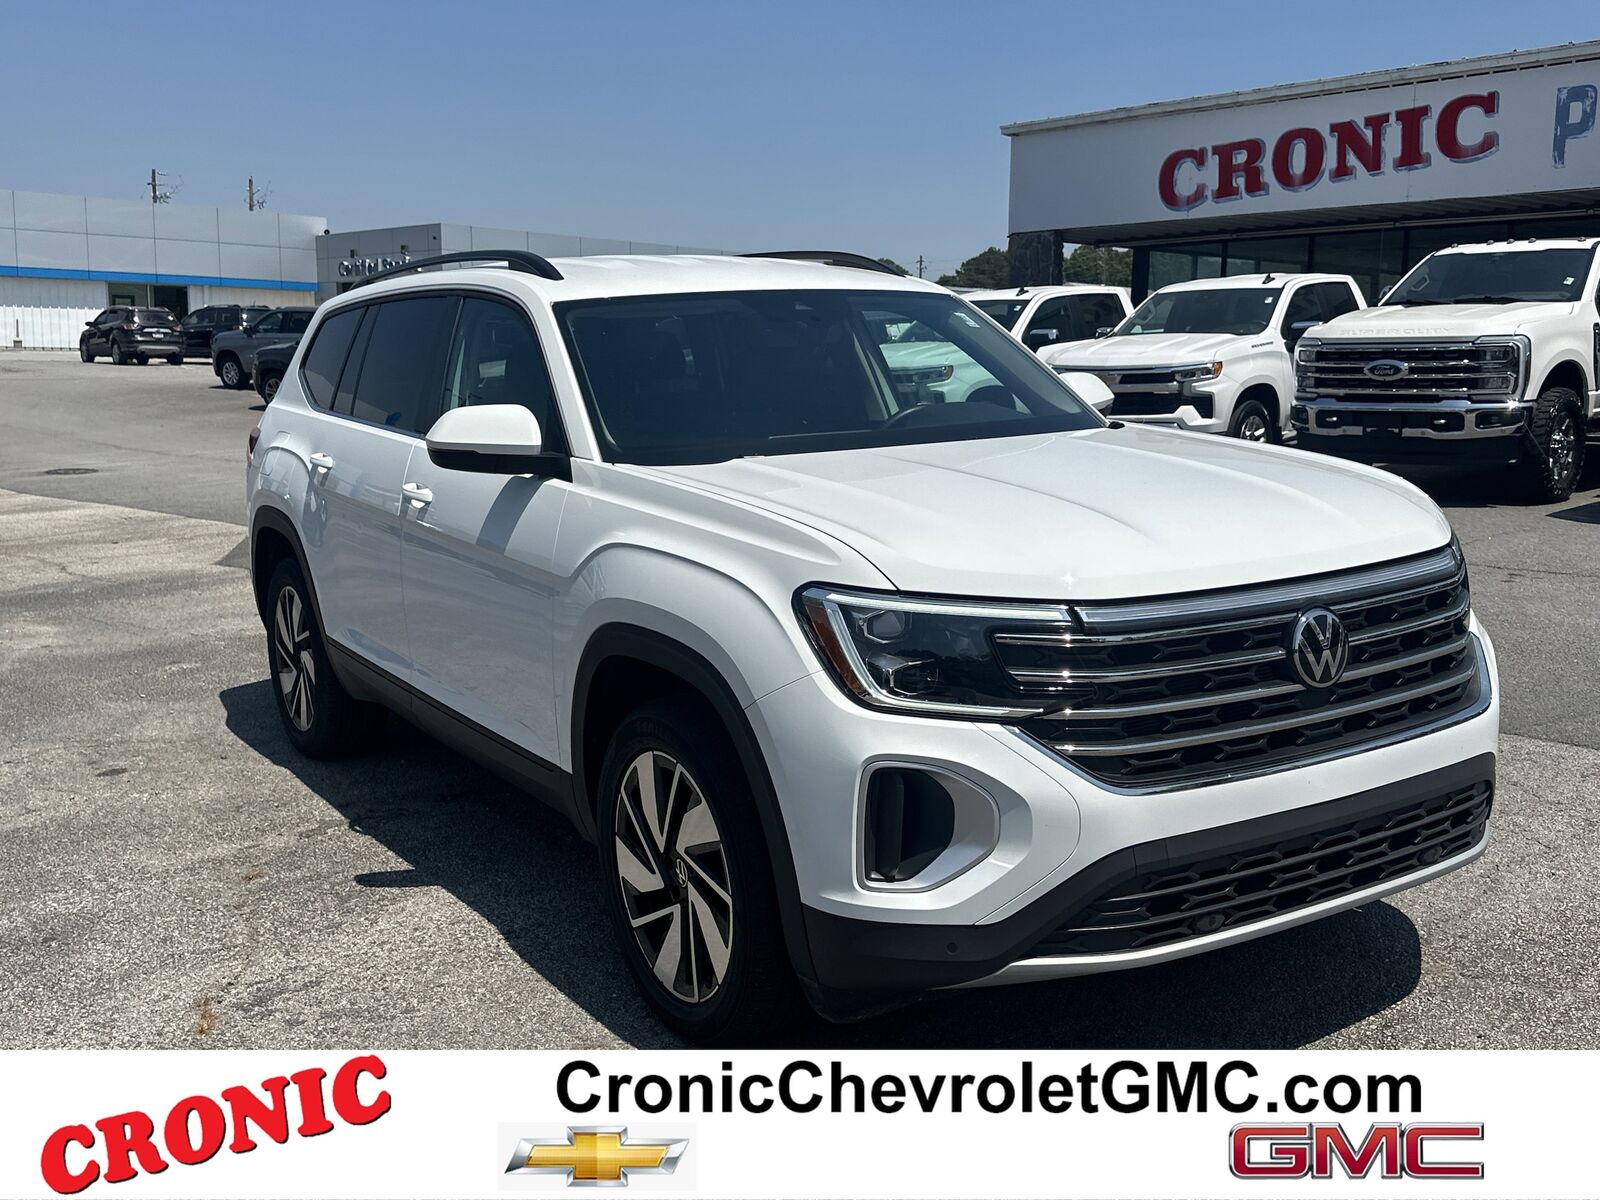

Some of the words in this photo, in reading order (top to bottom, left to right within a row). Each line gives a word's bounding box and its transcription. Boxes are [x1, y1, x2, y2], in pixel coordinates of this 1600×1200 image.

[1158, 91, 1499, 211] CRONIC
[1552, 84, 1598, 169] P
[1373, 364, 1395, 376] Ford
